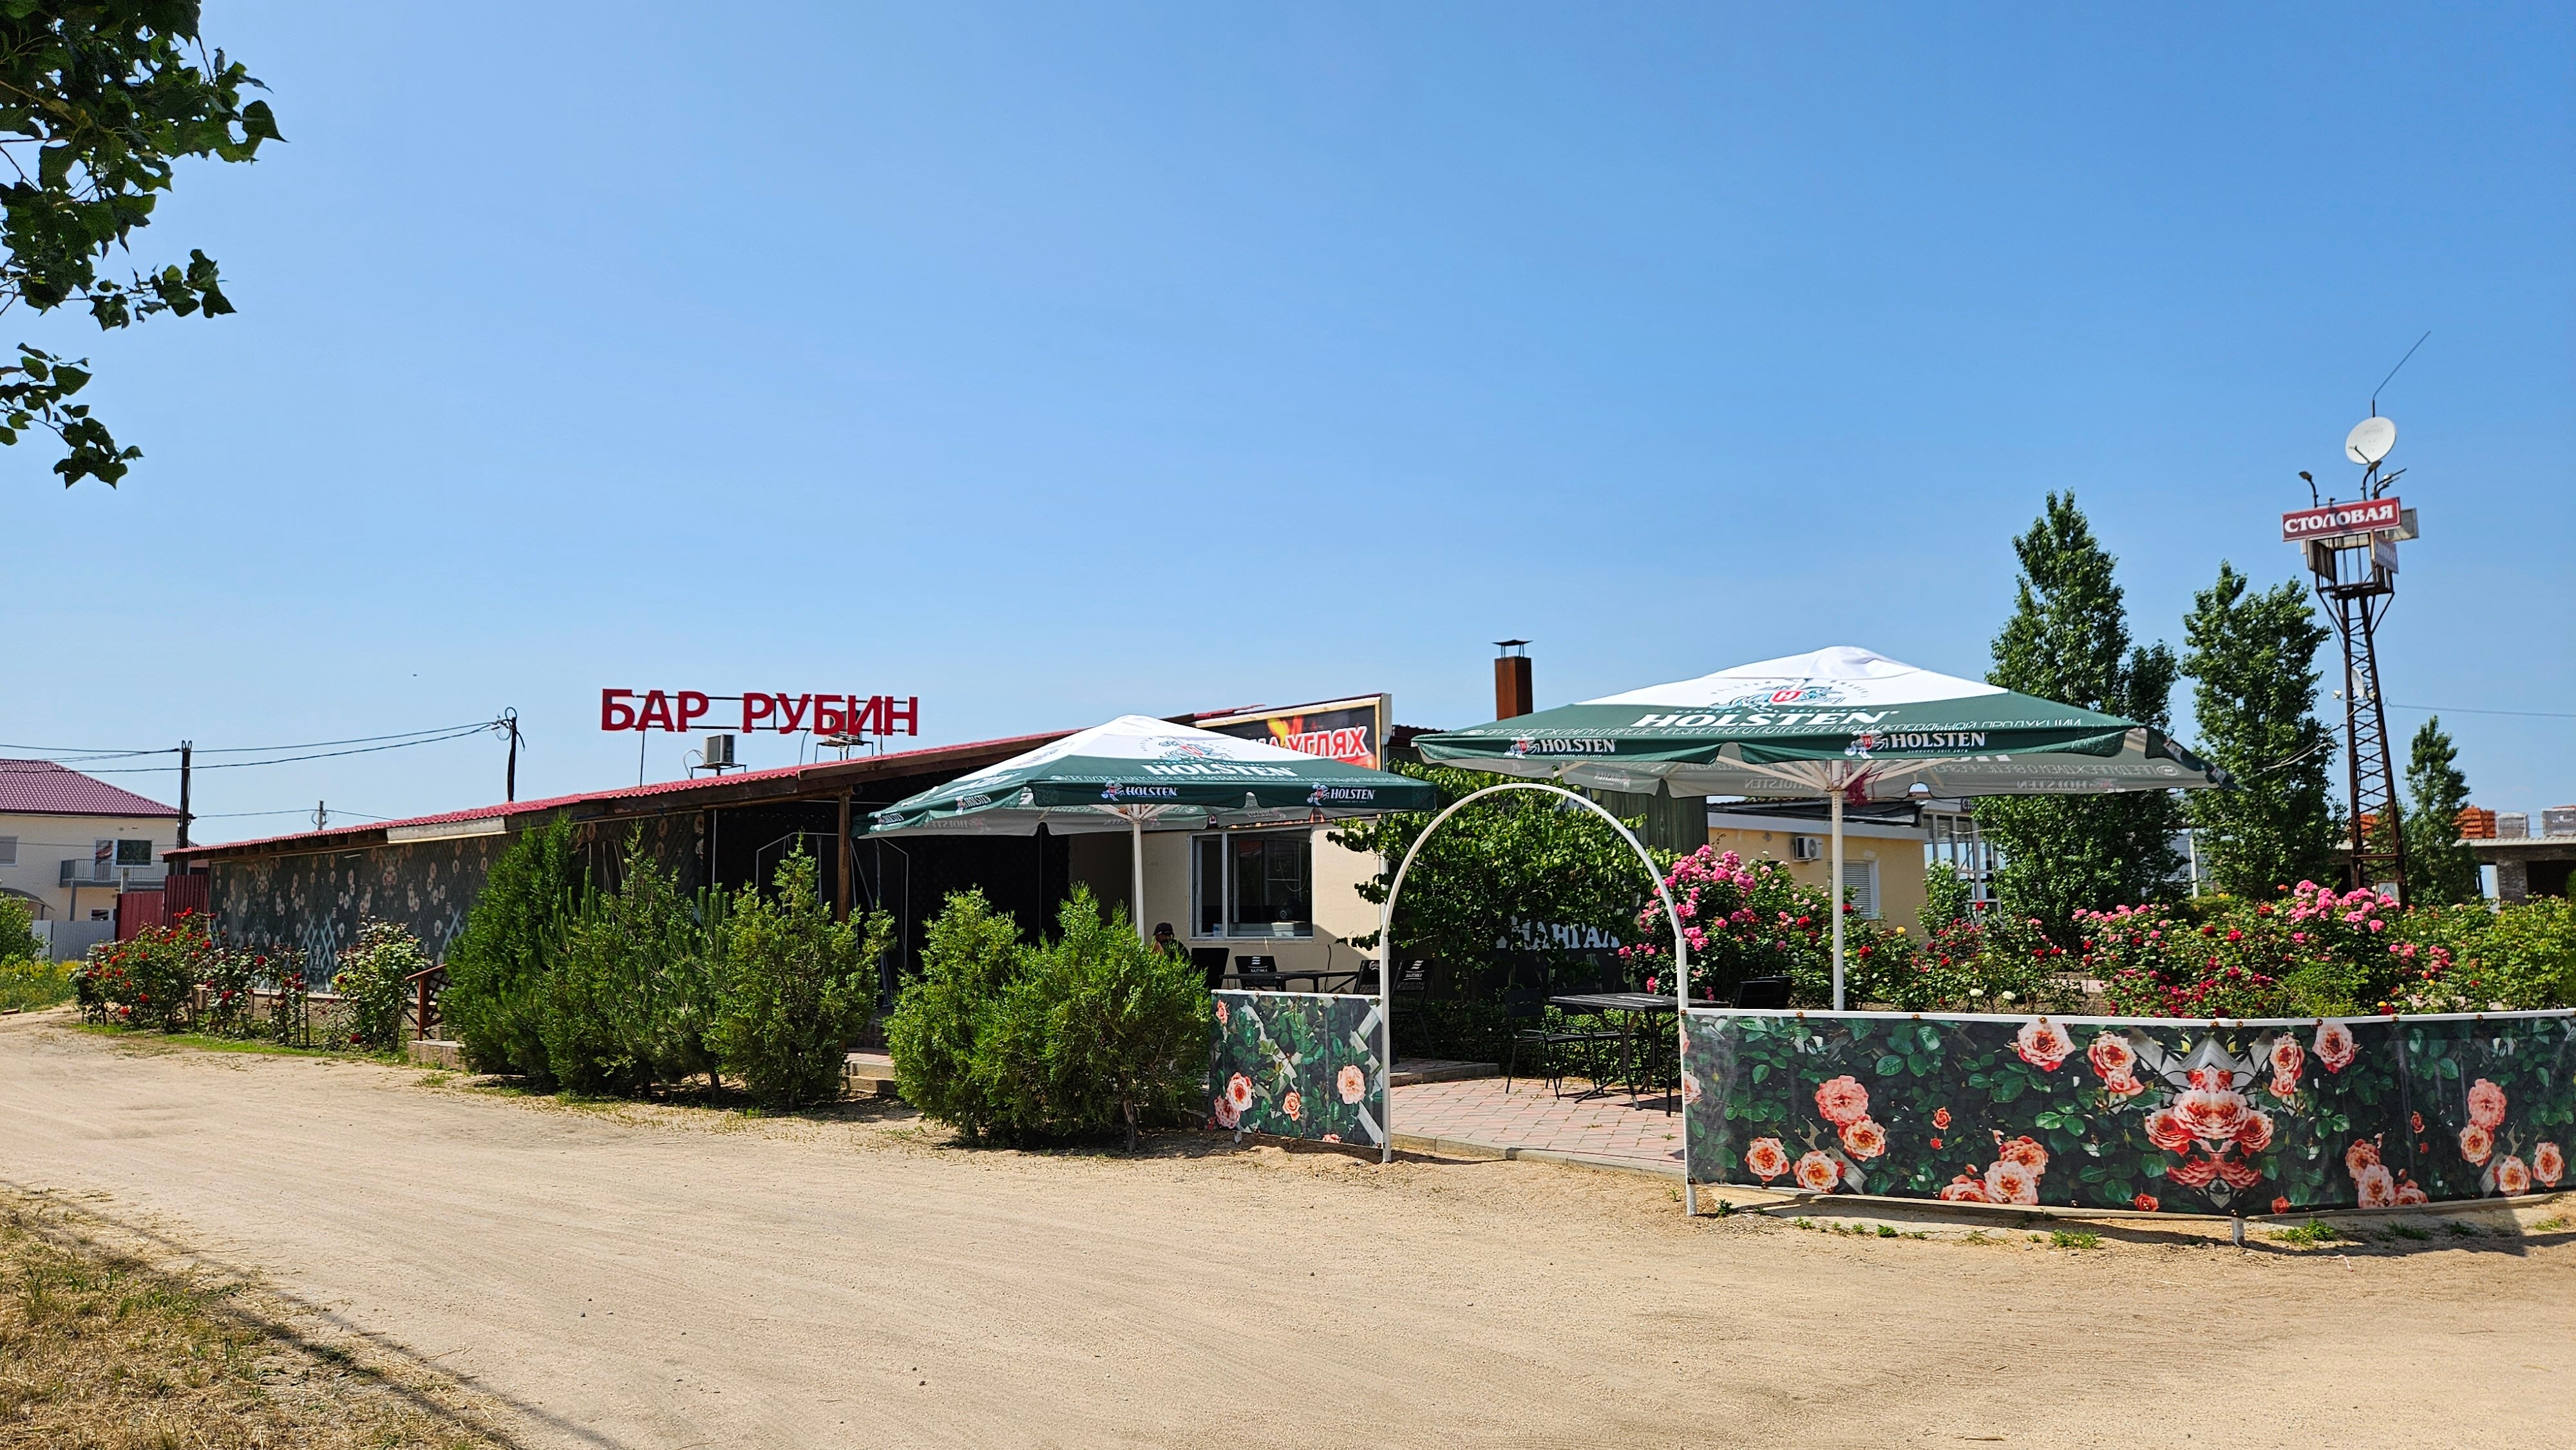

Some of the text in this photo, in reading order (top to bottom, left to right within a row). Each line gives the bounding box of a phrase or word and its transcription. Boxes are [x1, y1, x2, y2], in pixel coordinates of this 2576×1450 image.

[2284, 504, 2393, 533] СТОЛОВАЯ
[601, 688, 918, 737] БАР РУБИН
[1629, 711, 1892, 727] HOLSTEN
[1286, 726, 1368, 758] УГЛЯХ
[1540, 738, 1616, 753] HOLSTEN
[1889, 731, 1985, 748] HOLSTEN
[1141, 764, 1298, 777] HOLSTEN
[1125, 786, 1178, 797] HOLSTEN
[1330, 788, 1375, 800] HOLSTEN
